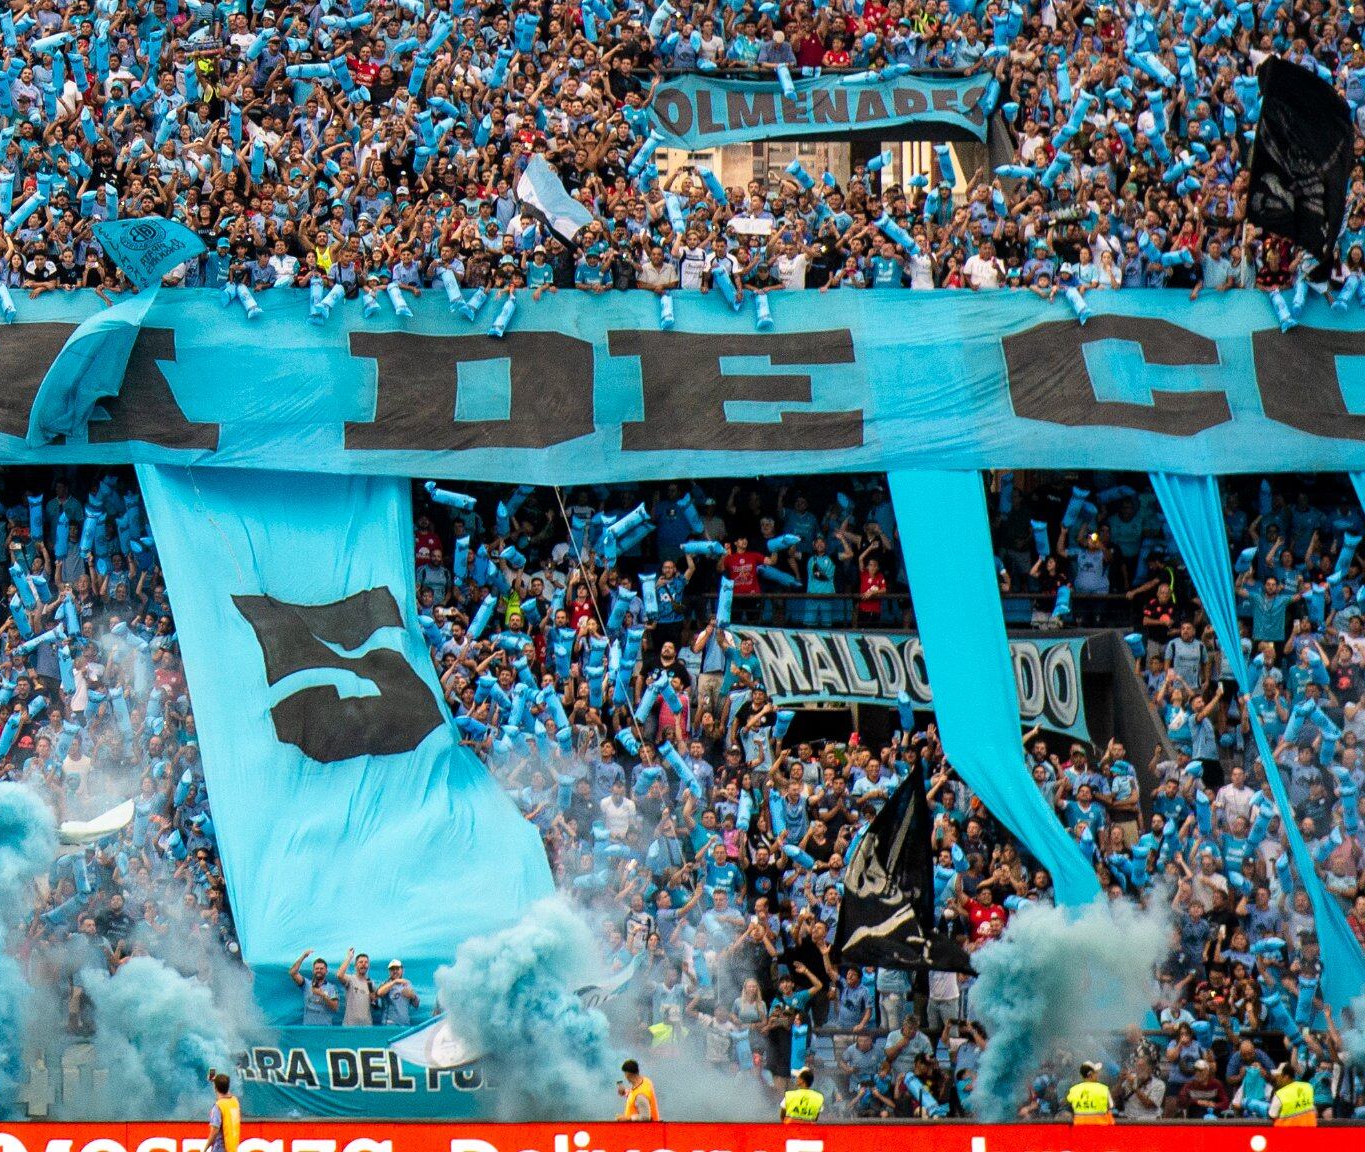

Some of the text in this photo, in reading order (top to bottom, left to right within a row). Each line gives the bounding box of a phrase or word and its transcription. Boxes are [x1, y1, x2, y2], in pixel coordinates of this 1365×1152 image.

[644, 86, 986, 137] OLMENARES
[344, 328, 865, 452] DE
[231, 585, 446, 764] 5
[749, 629, 1080, 728] MALDODO
[326, 1047, 416, 1092] DEL
